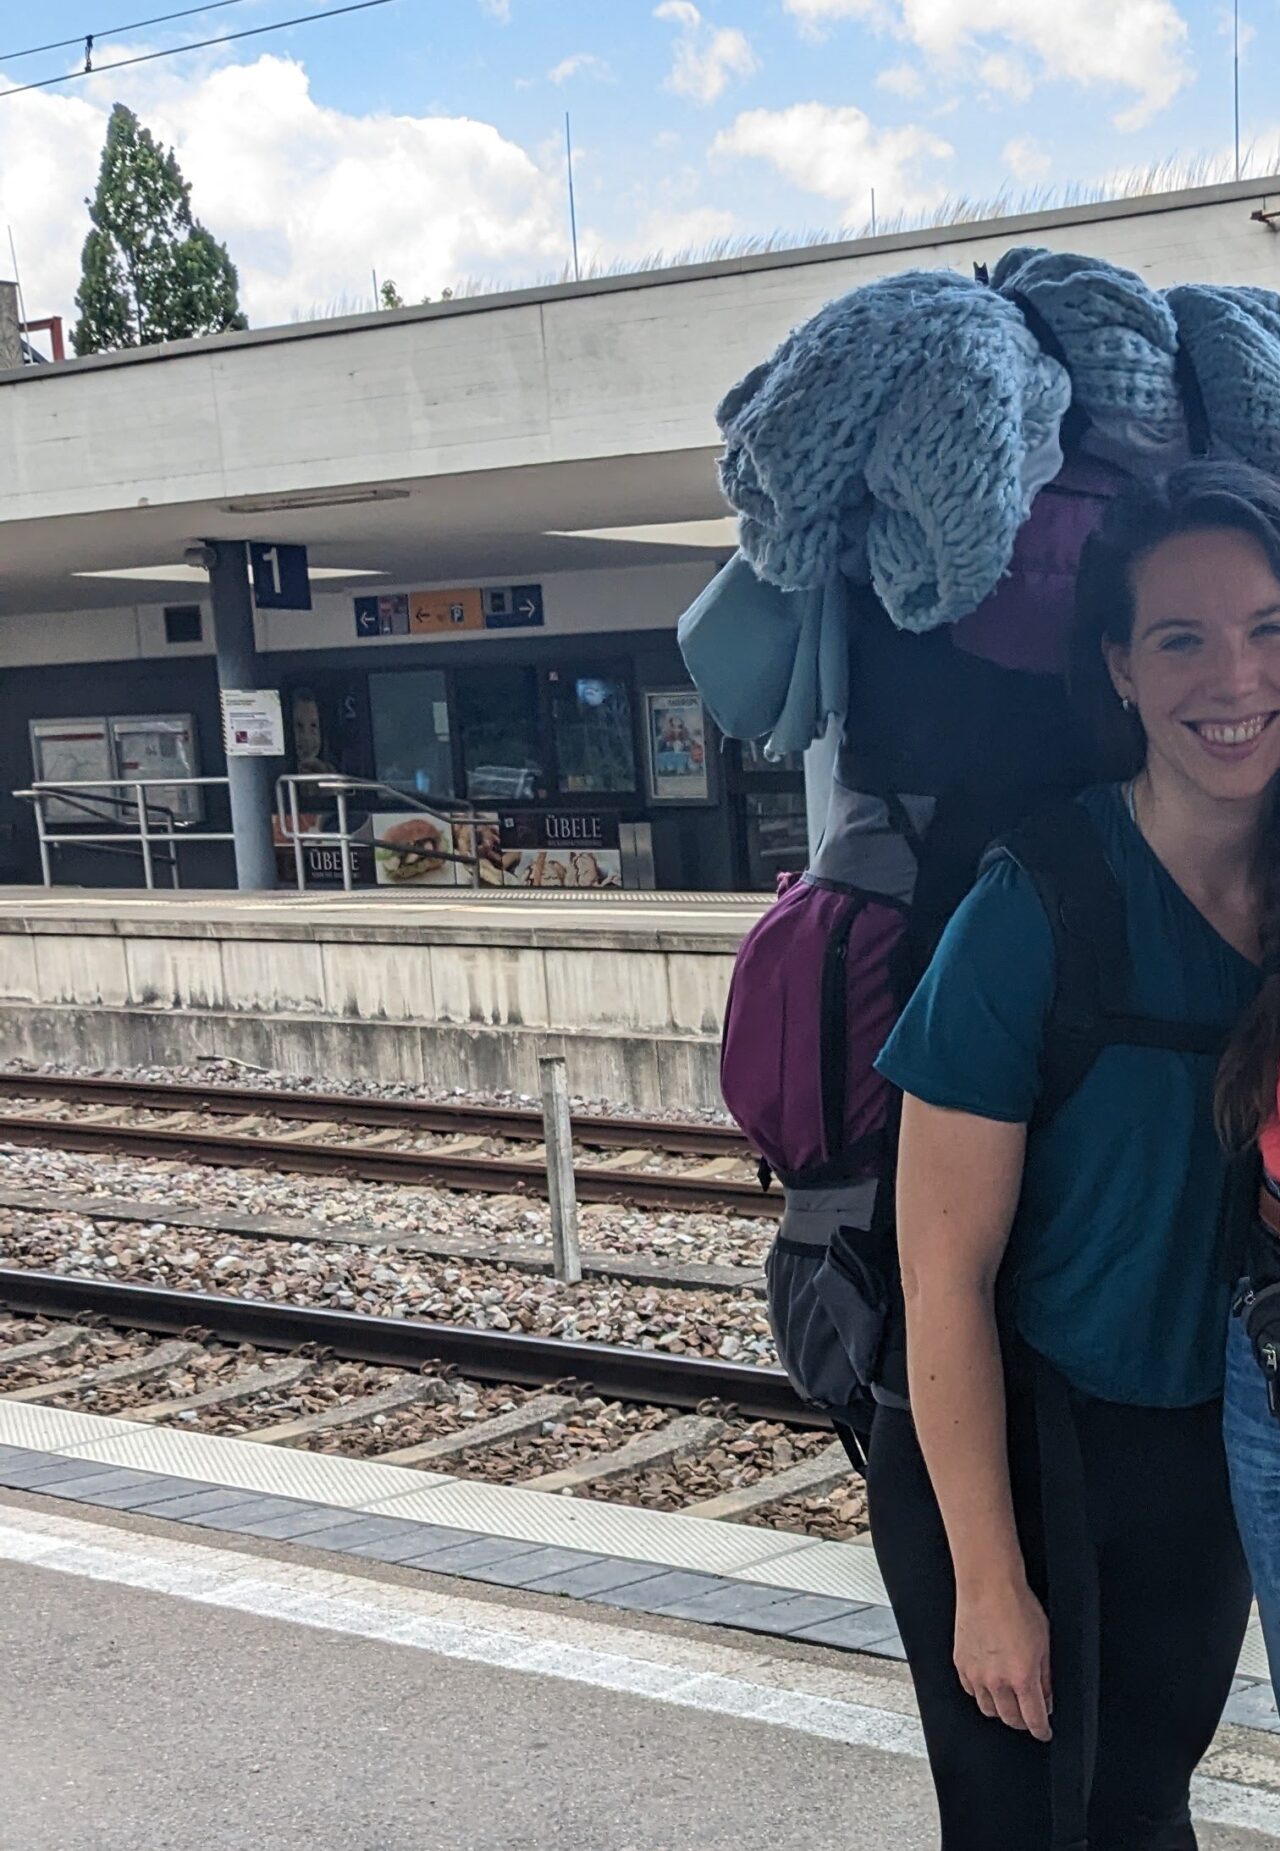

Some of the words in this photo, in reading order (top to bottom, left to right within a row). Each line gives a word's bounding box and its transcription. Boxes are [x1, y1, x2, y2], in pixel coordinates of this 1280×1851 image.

[262, 547, 281, 593] 1
[545, 814, 602, 838] ÜBELE
[310, 849, 360, 871] ÜBEE
